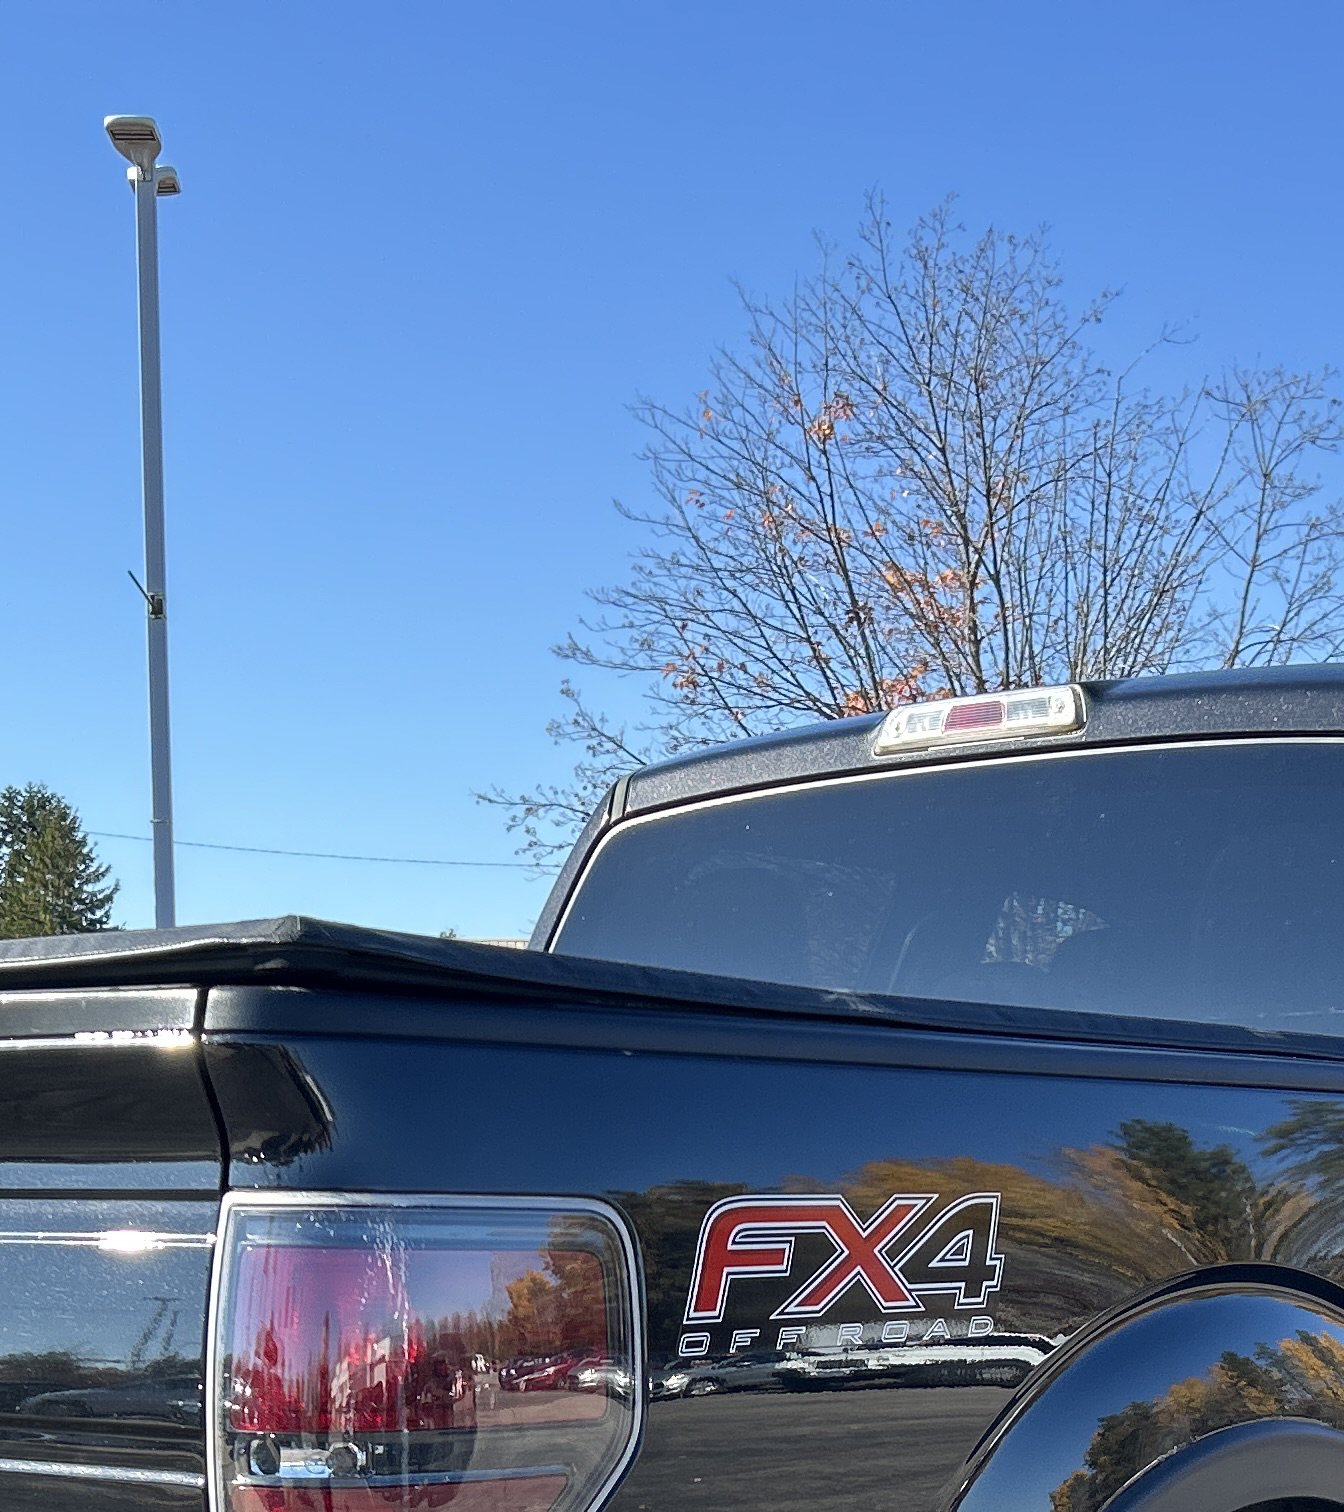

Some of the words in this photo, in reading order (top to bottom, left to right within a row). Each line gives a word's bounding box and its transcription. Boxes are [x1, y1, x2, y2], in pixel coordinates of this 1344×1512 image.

[683, 1192, 1005, 1325] FX4
[679, 1325, 807, 1357] OFF
[836, 1315, 995, 1346] ROAD
